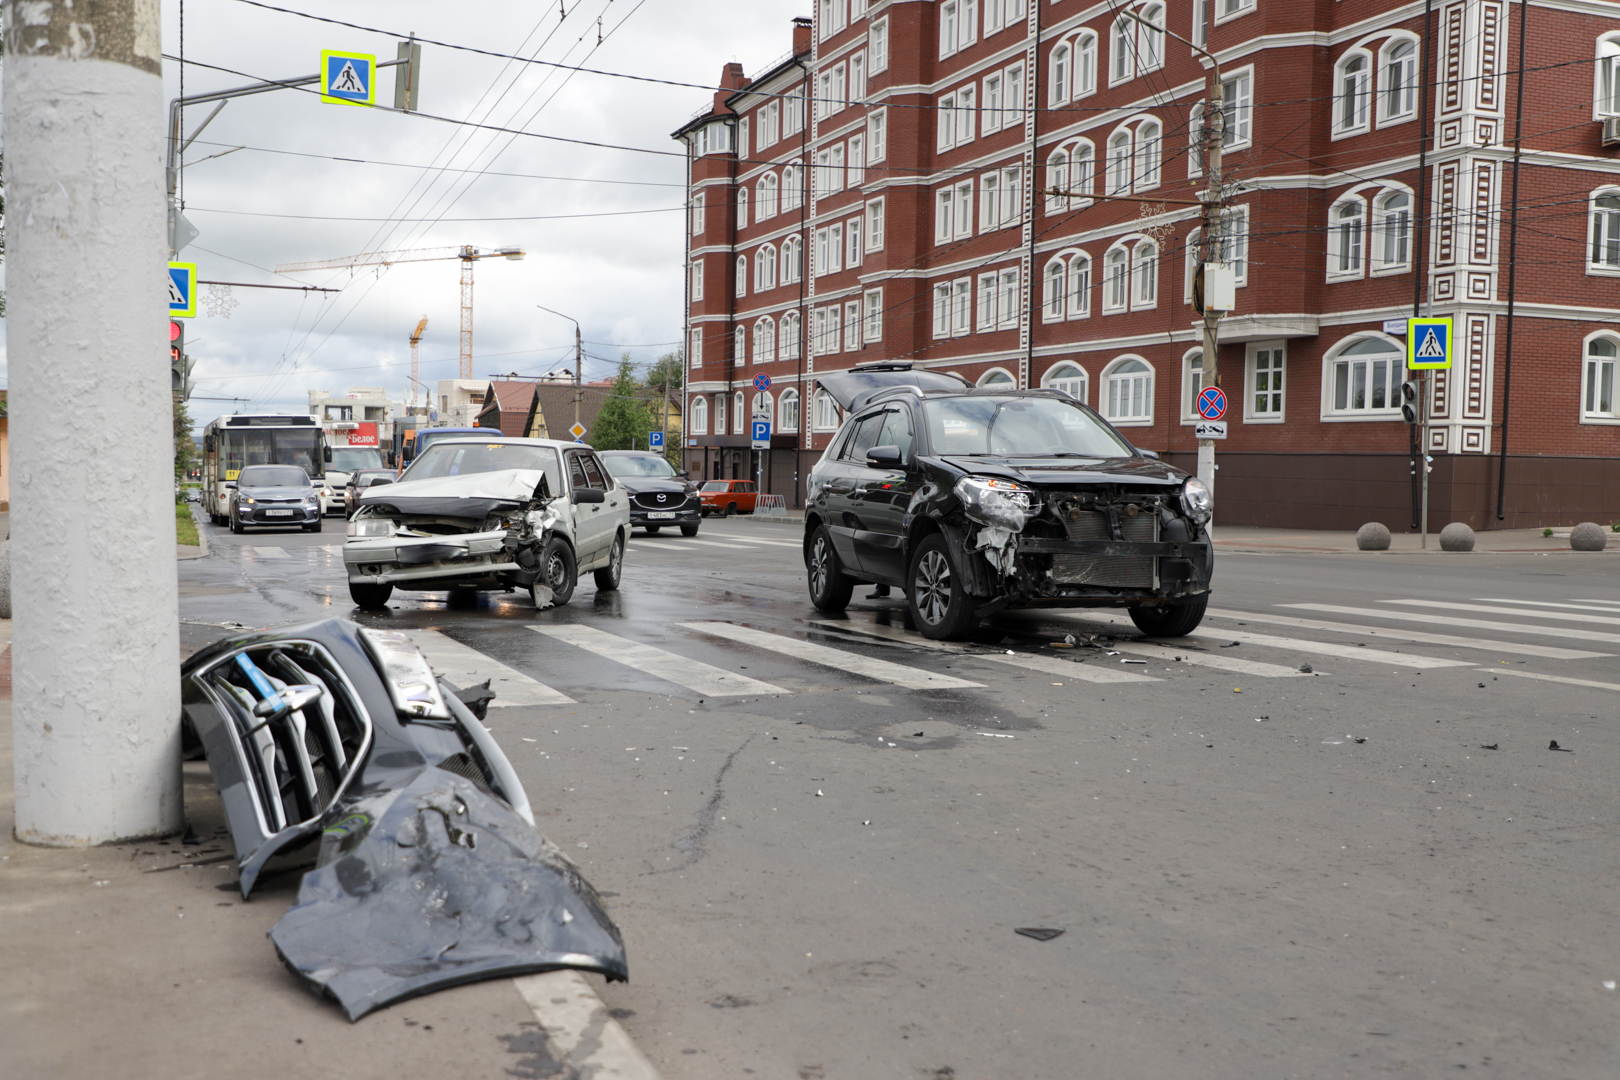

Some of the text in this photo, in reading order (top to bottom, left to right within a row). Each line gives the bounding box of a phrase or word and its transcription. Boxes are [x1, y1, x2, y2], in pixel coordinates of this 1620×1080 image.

[756, 424, 767, 439] P
[352, 433, 375, 443] Белое
[652, 433, 661, 445] P
